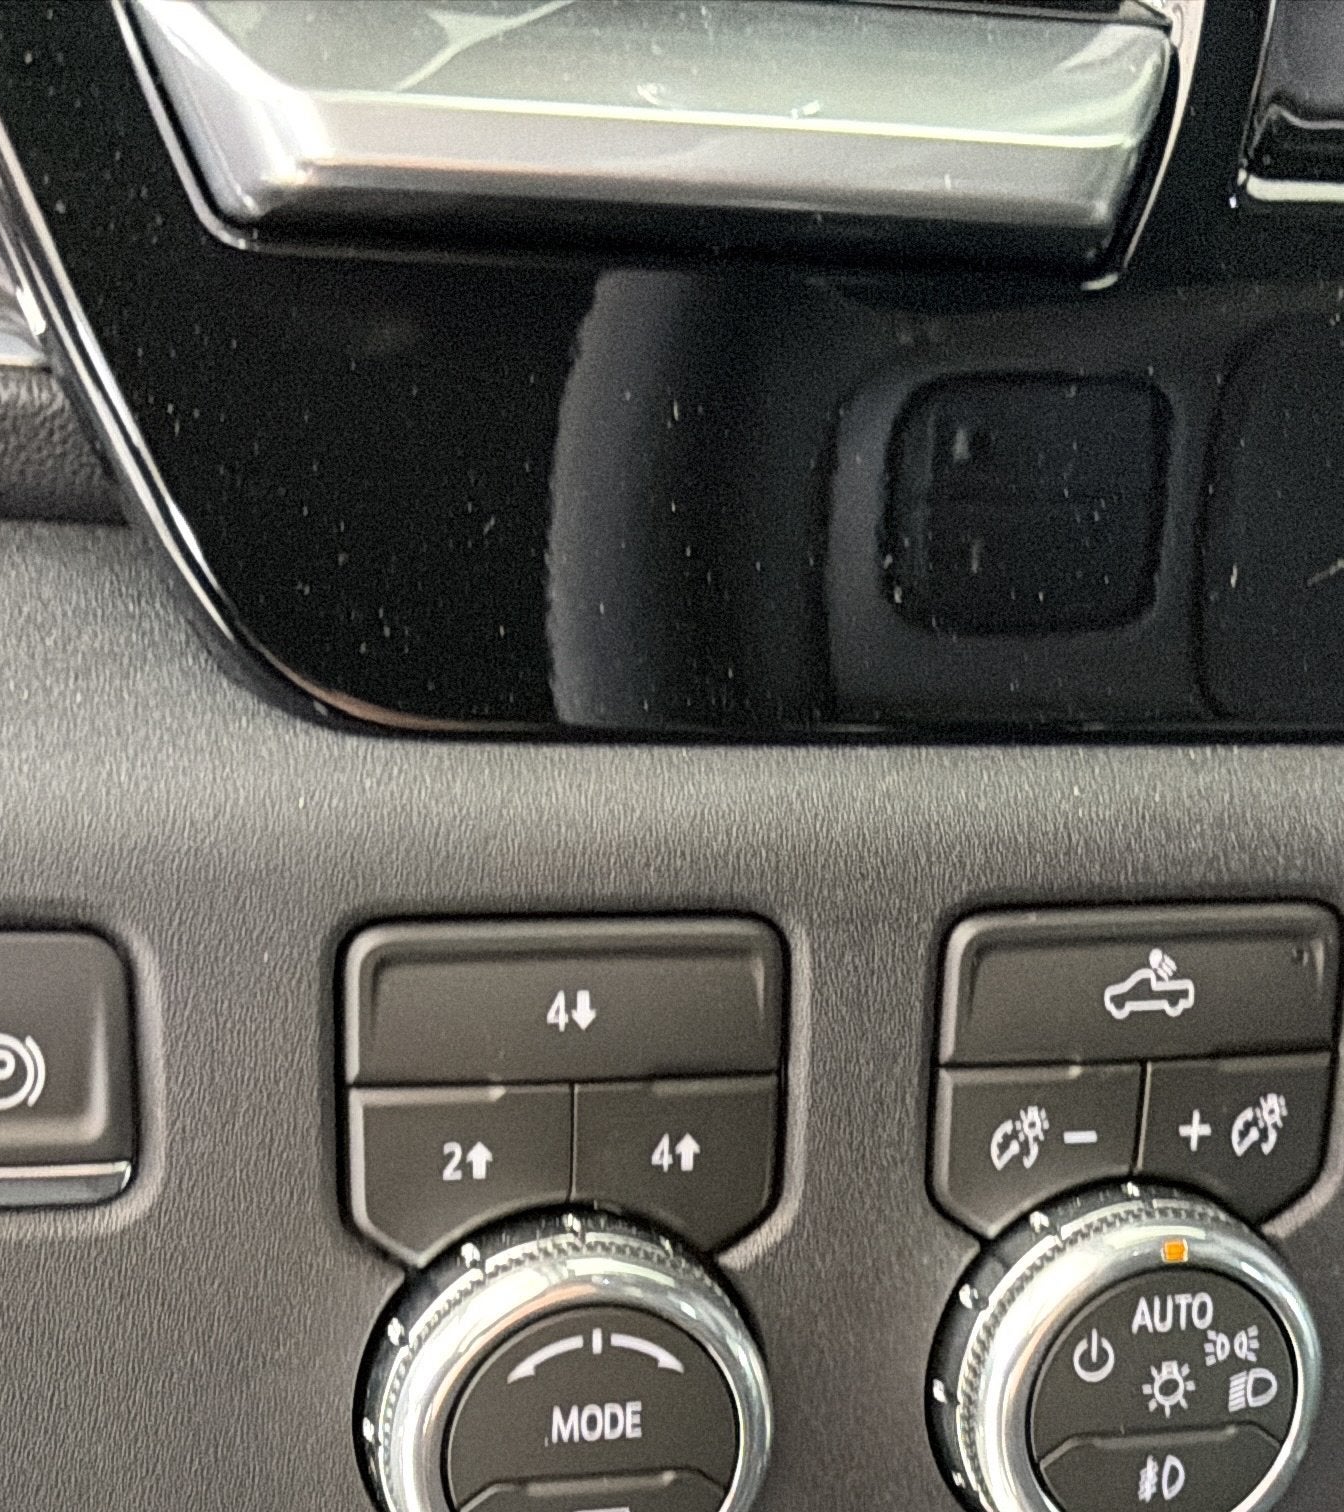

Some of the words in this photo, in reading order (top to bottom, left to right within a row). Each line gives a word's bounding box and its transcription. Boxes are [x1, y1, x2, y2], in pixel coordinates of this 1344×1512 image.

[546, 989, 569, 1032] 4
[442, 1141, 463, 1181] 2
[651, 1133, 673, 1172] 4
[1131, 1292, 1214, 1335] AUTO
[551, 1400, 643, 1443] MODE
